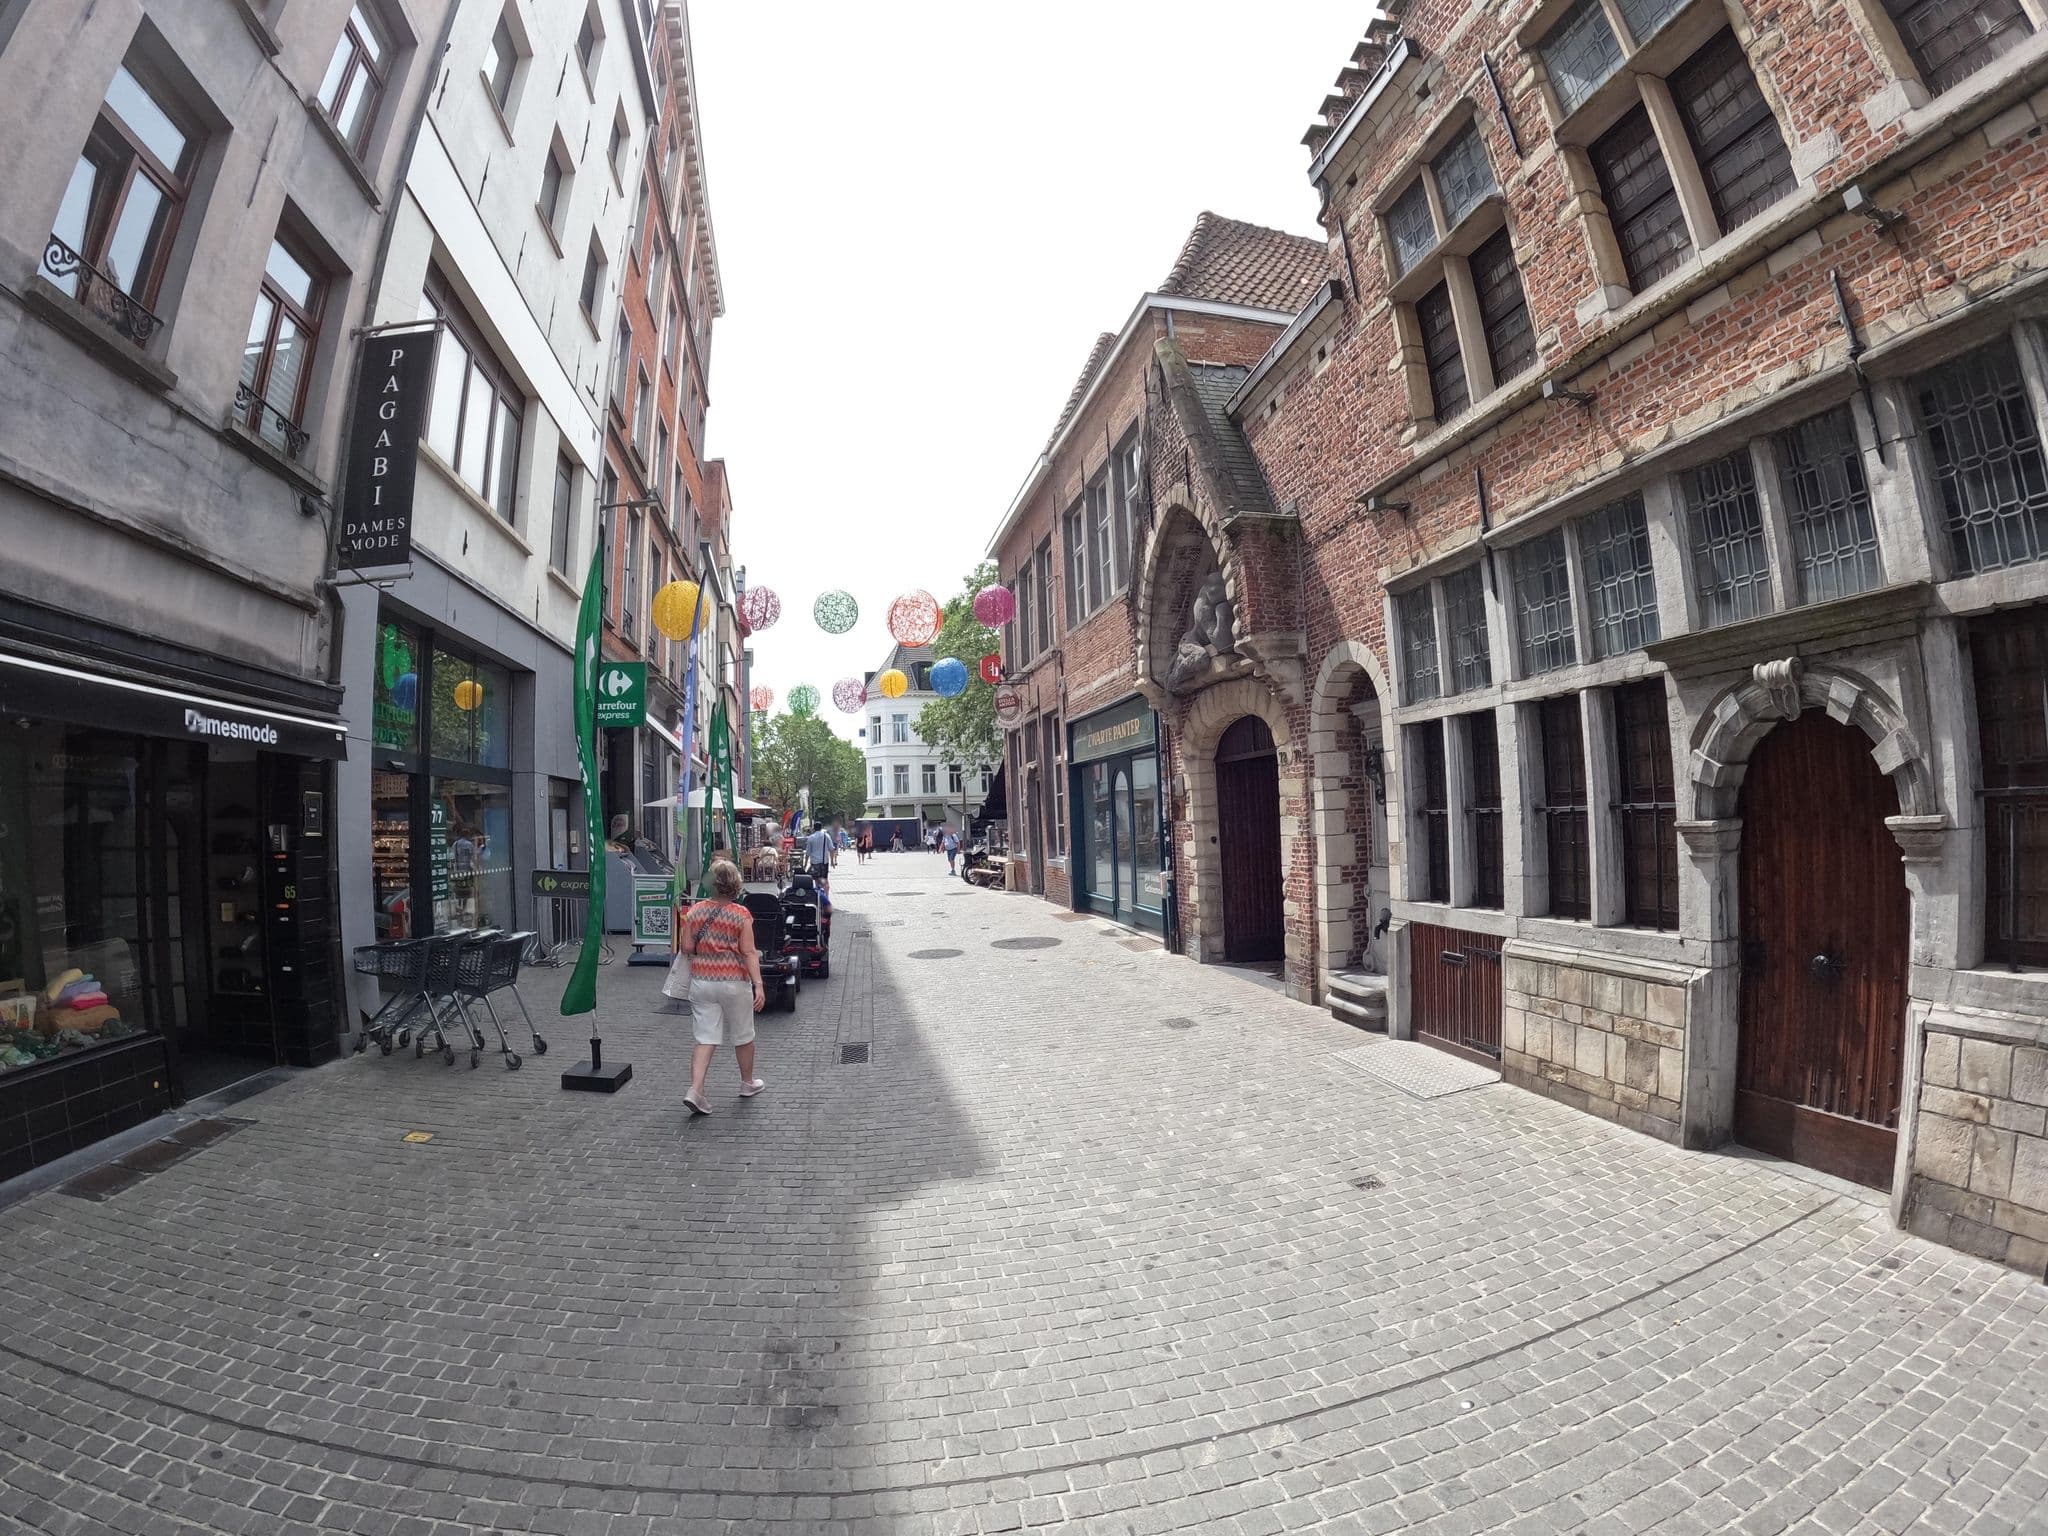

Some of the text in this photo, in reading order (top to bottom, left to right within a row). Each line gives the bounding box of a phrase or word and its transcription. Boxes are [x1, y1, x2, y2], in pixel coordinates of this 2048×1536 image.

[372, 348, 405, 507] PAGABI
[346, 517, 406, 536] DAMES
[350, 534, 400, 551] MODE
[598, 700, 638, 710] arrefour
[1113, 718, 1140, 741] PANTER
[284, 885, 296, 899] 65
[560, 879, 590, 891] expre
